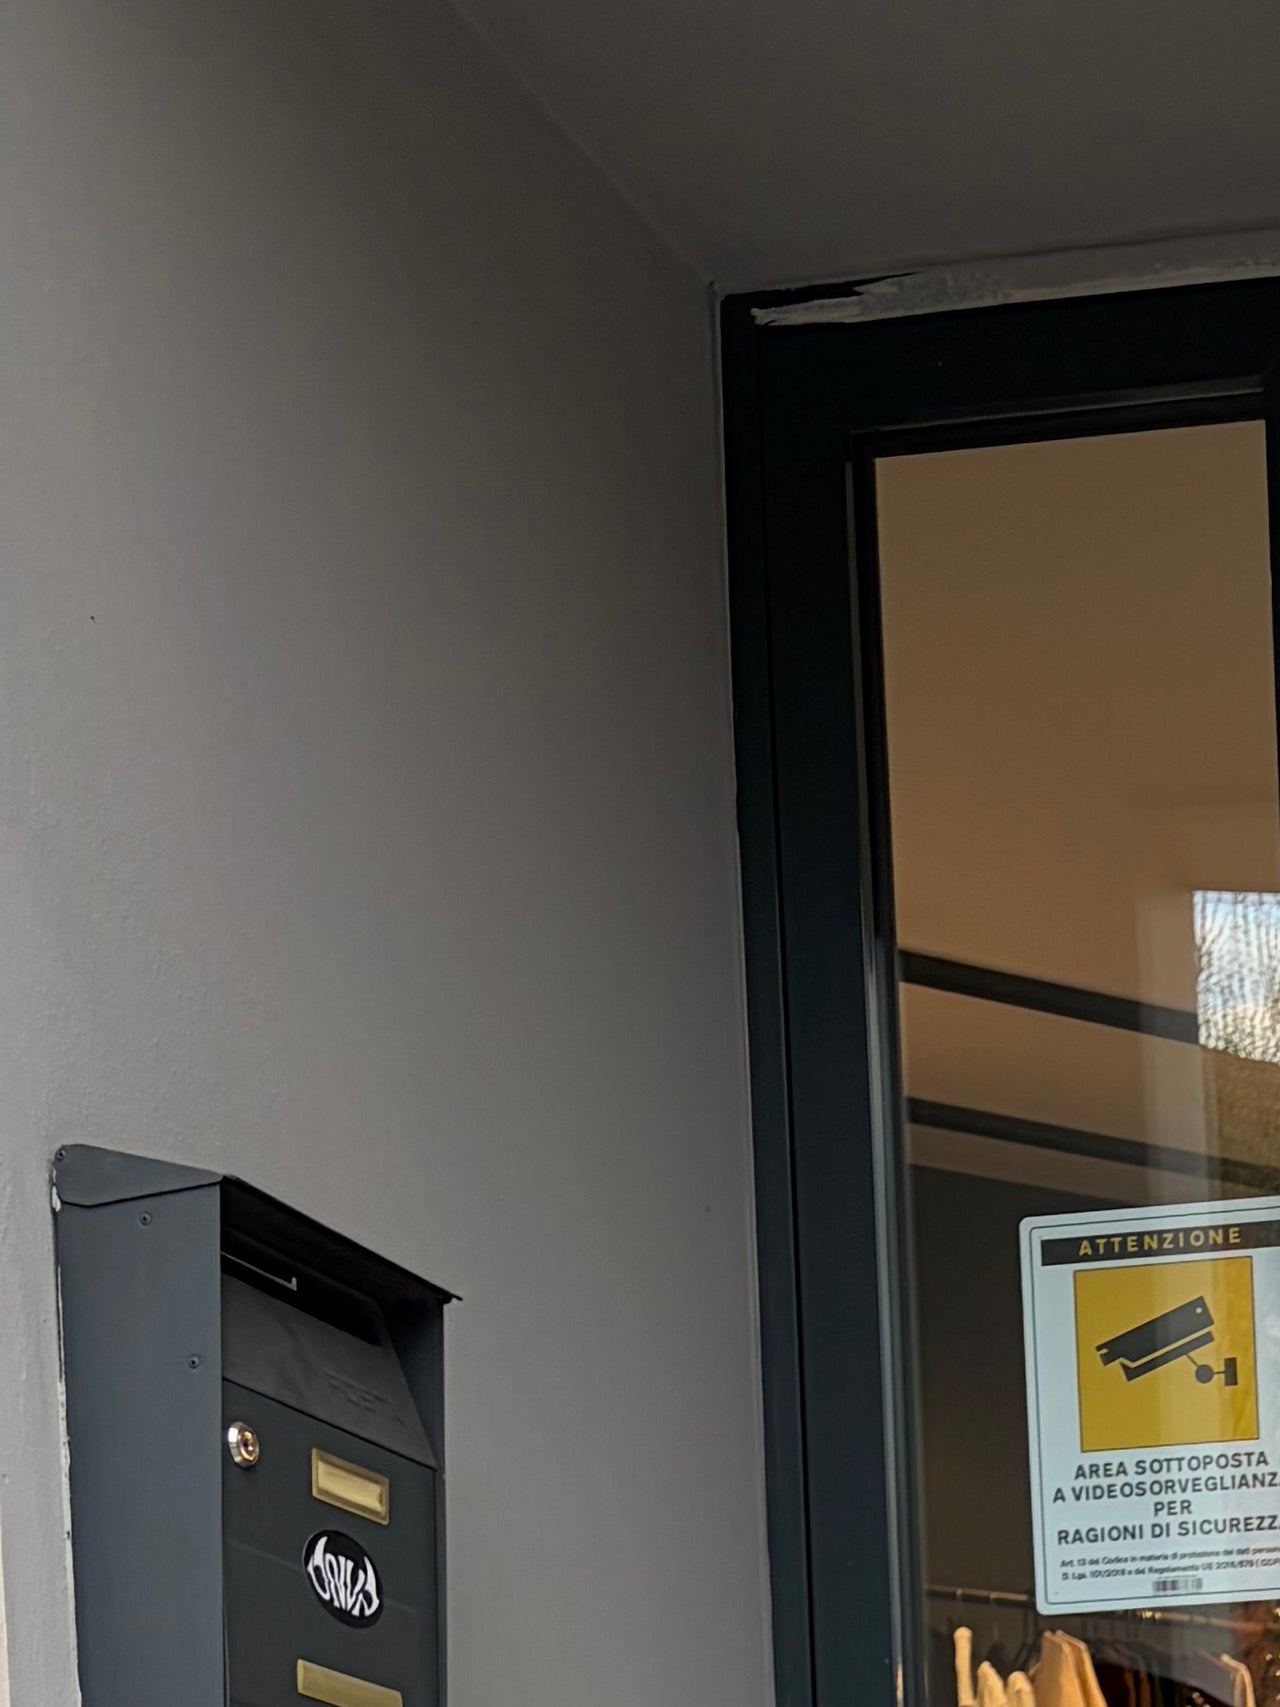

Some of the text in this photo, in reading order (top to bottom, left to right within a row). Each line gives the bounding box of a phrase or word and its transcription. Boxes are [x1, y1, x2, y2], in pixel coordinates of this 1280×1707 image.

[1078, 1227, 1242, 1257] ATTENZIONE
[1074, 1451, 1269, 1481] AREA SOTTOPOSTA
[1052, 1487, 1066, 1504] A
[1153, 1499, 1192, 1517] PER
[1057, 1524, 1144, 1545] RAGIONI
[1151, 1522, 1170, 1539] DI
